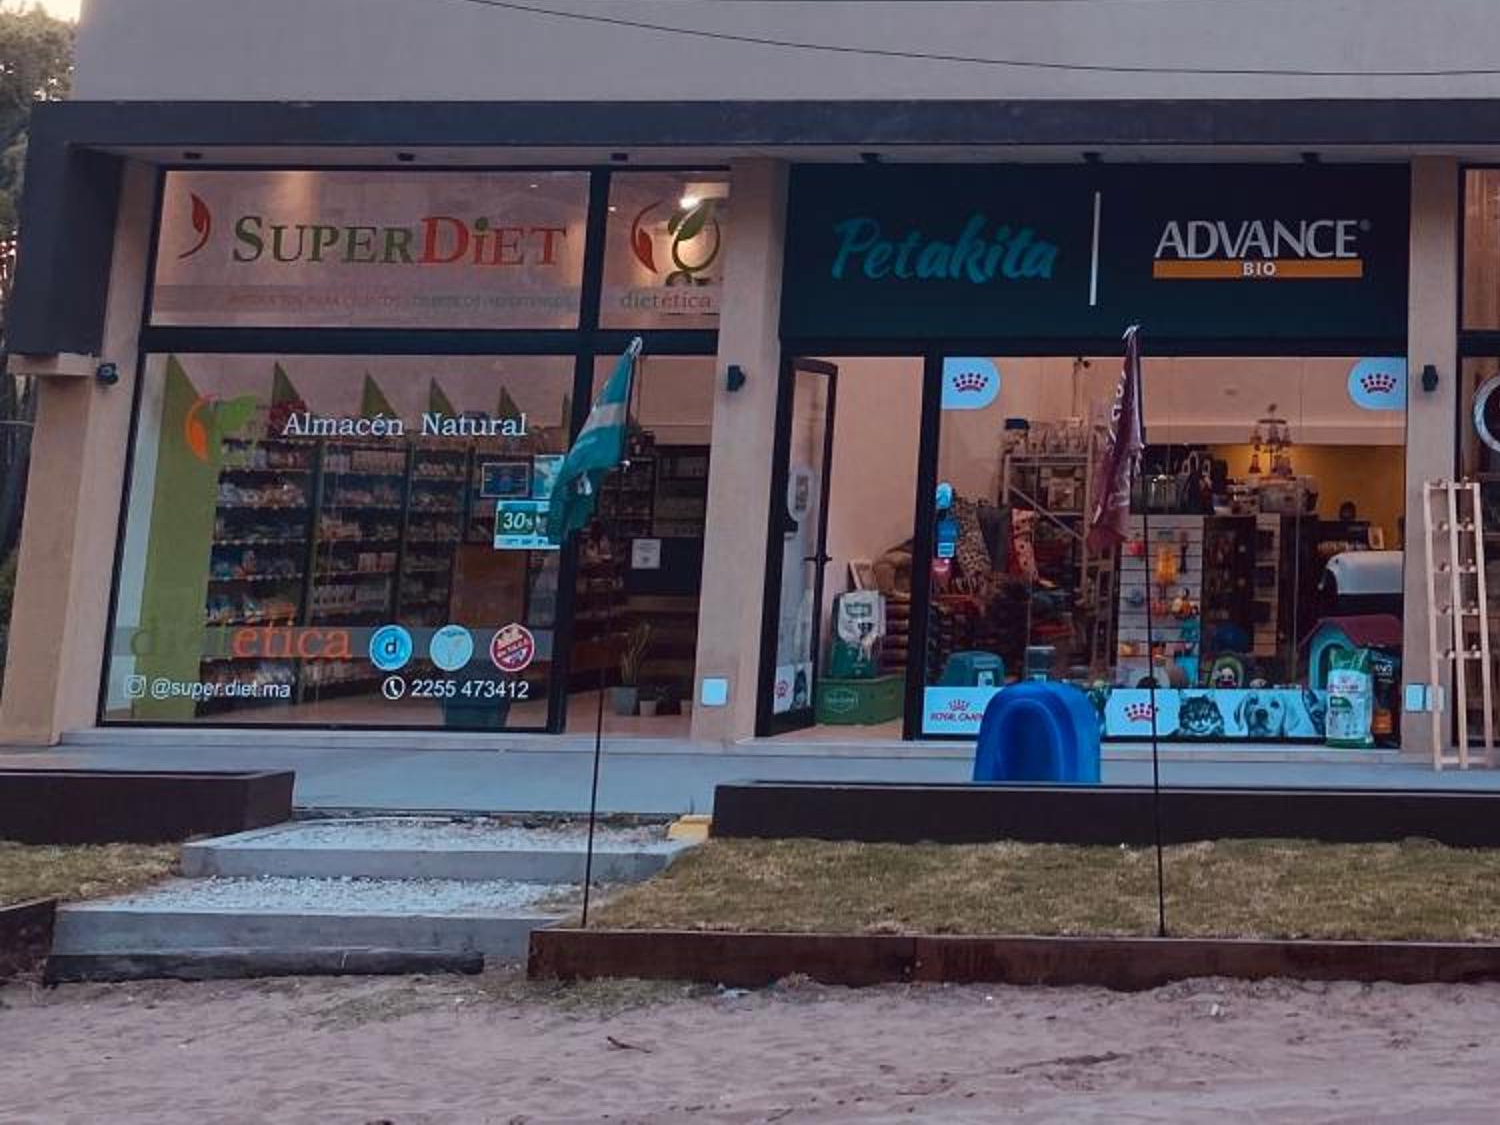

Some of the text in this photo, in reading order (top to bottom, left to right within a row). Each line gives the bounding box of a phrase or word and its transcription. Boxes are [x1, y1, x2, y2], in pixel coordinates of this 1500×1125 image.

[831, 212, 1057, 283] Petakita
[1154, 220, 1358, 258] ADVANCE
[1243, 261, 1276, 276] BIO
[282, 412, 528, 436] Almacén Natural
[411, 680, 529, 699] 2255 473412
